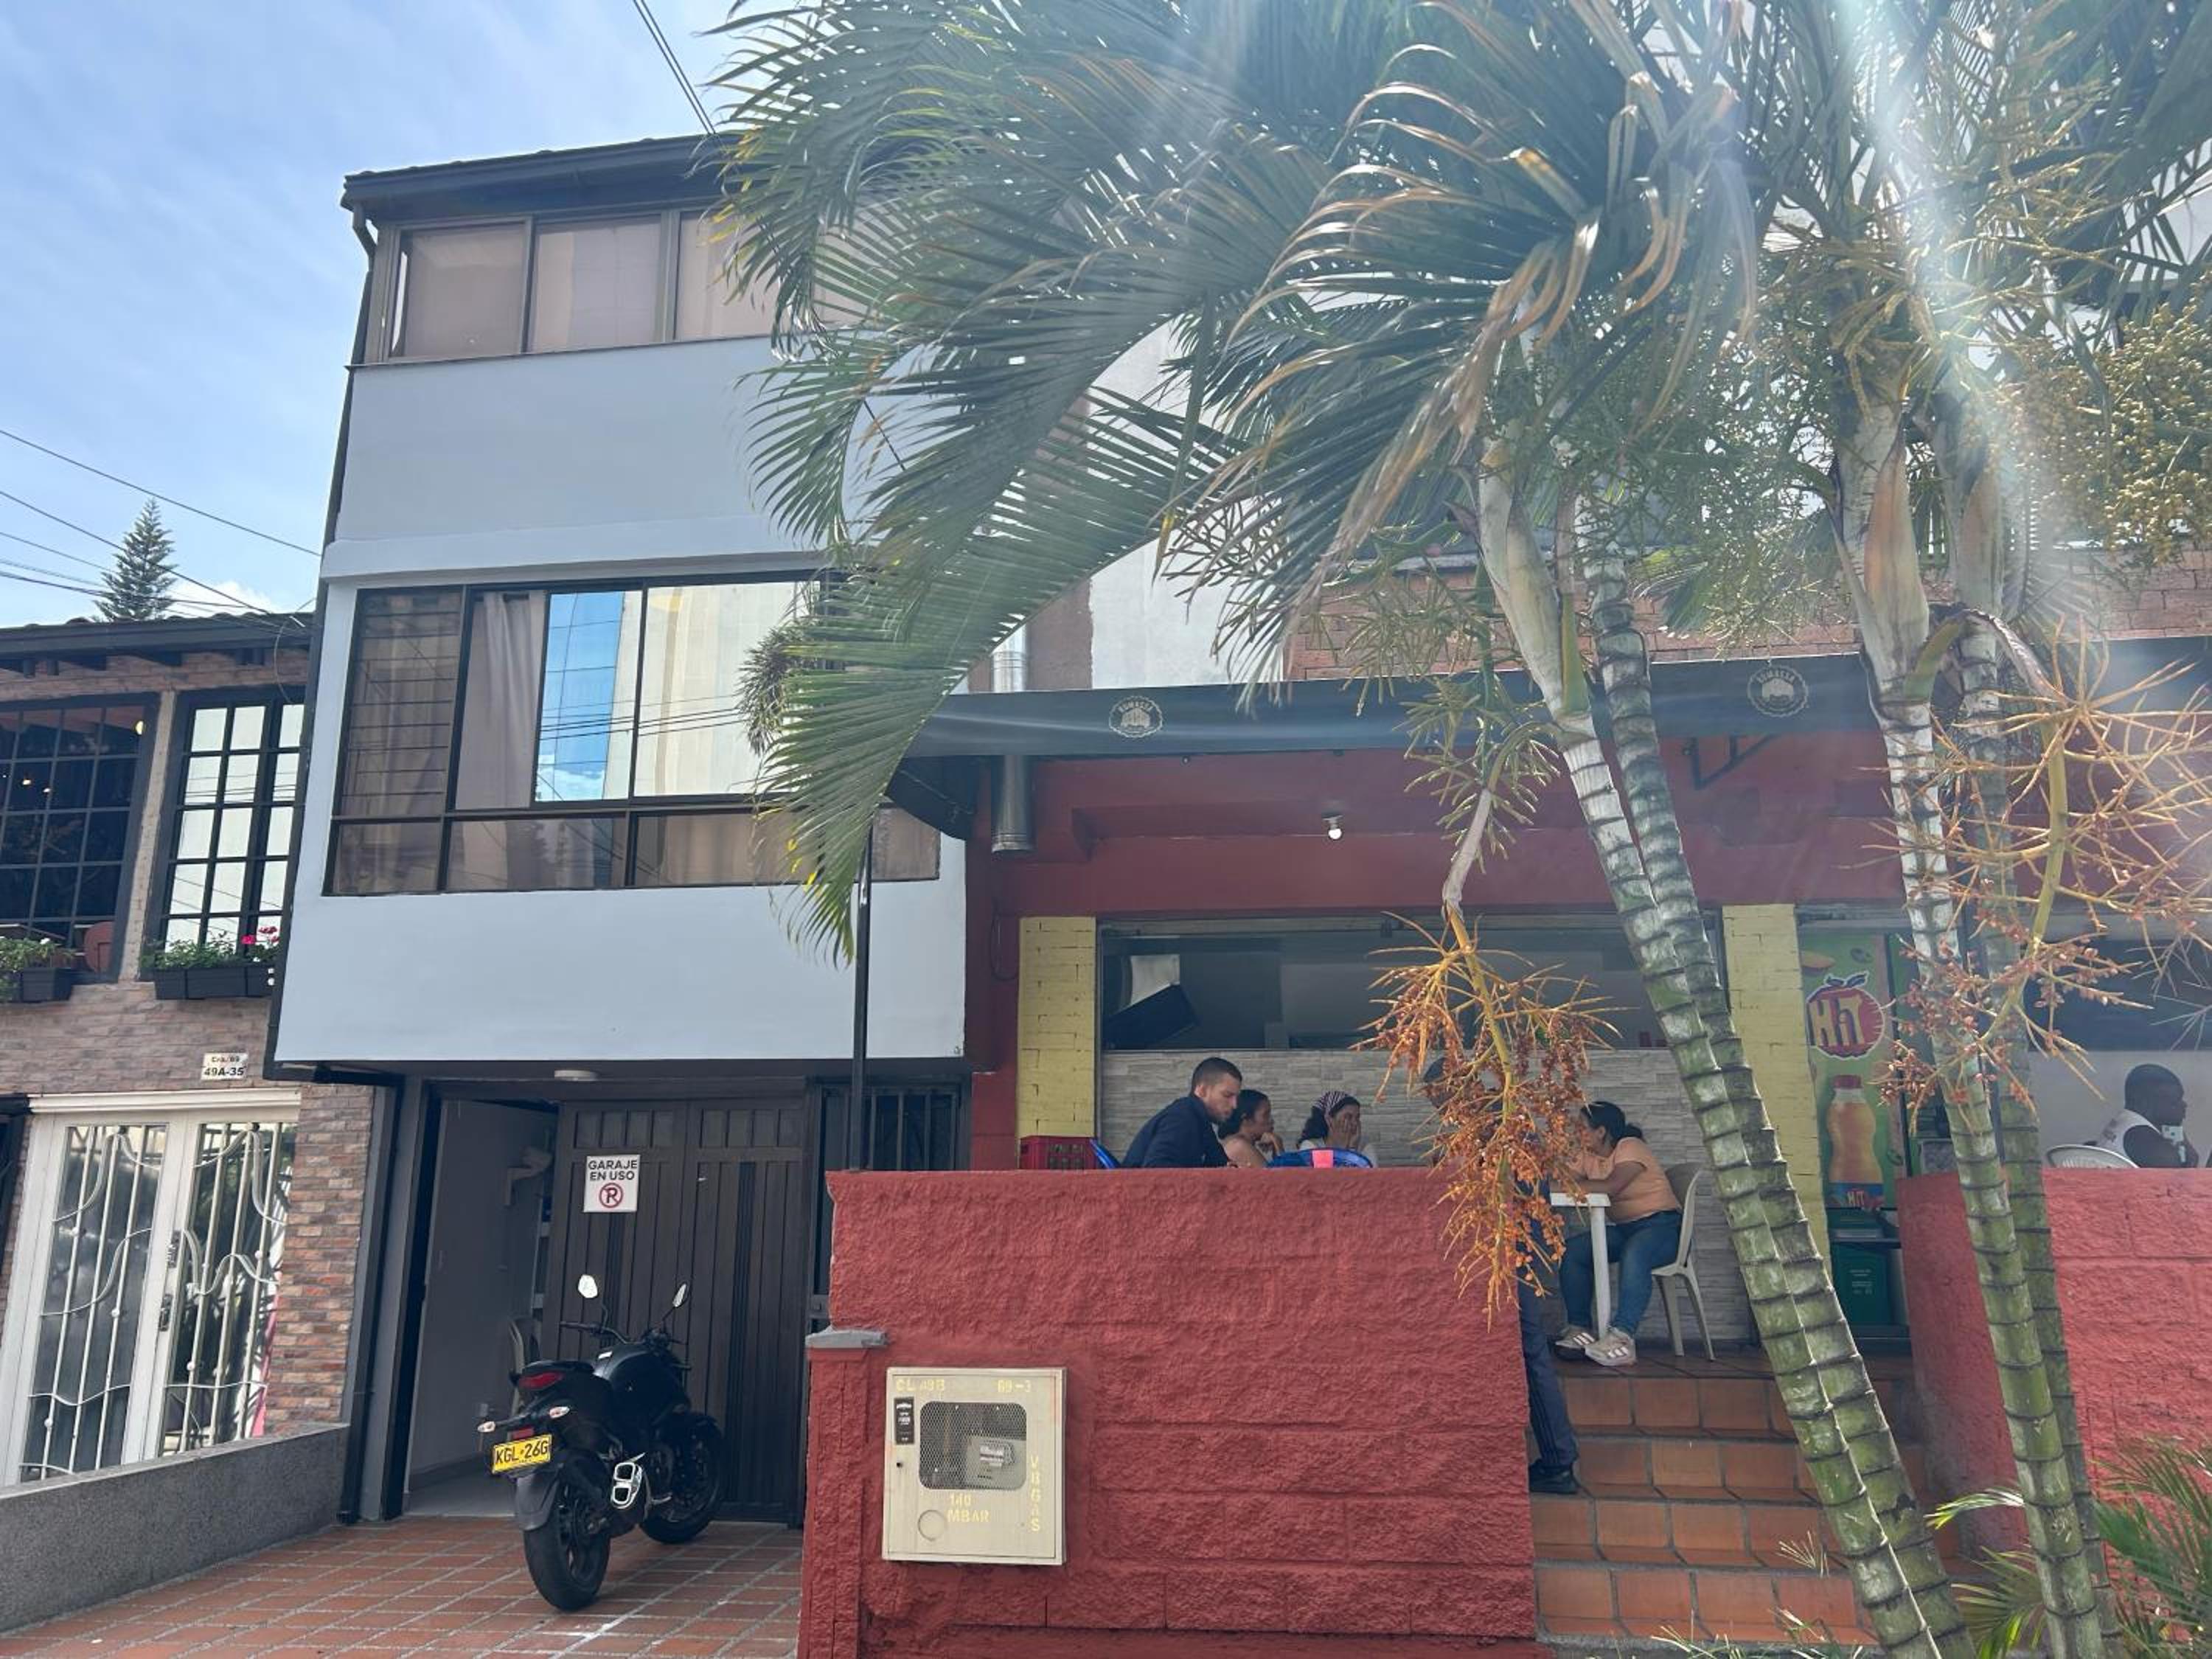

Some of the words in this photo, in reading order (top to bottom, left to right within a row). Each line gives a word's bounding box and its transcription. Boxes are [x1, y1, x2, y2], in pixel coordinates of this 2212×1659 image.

[204, 1067, 244, 1076] 49A-35
[588, 1160, 638, 1170] GARAJE
[590, 1172, 606, 1180] EN
[610, 1170, 635, 1180] USO
[495, 1445, 519, 1464] KGL
[524, 1440, 548, 1459] 26G
